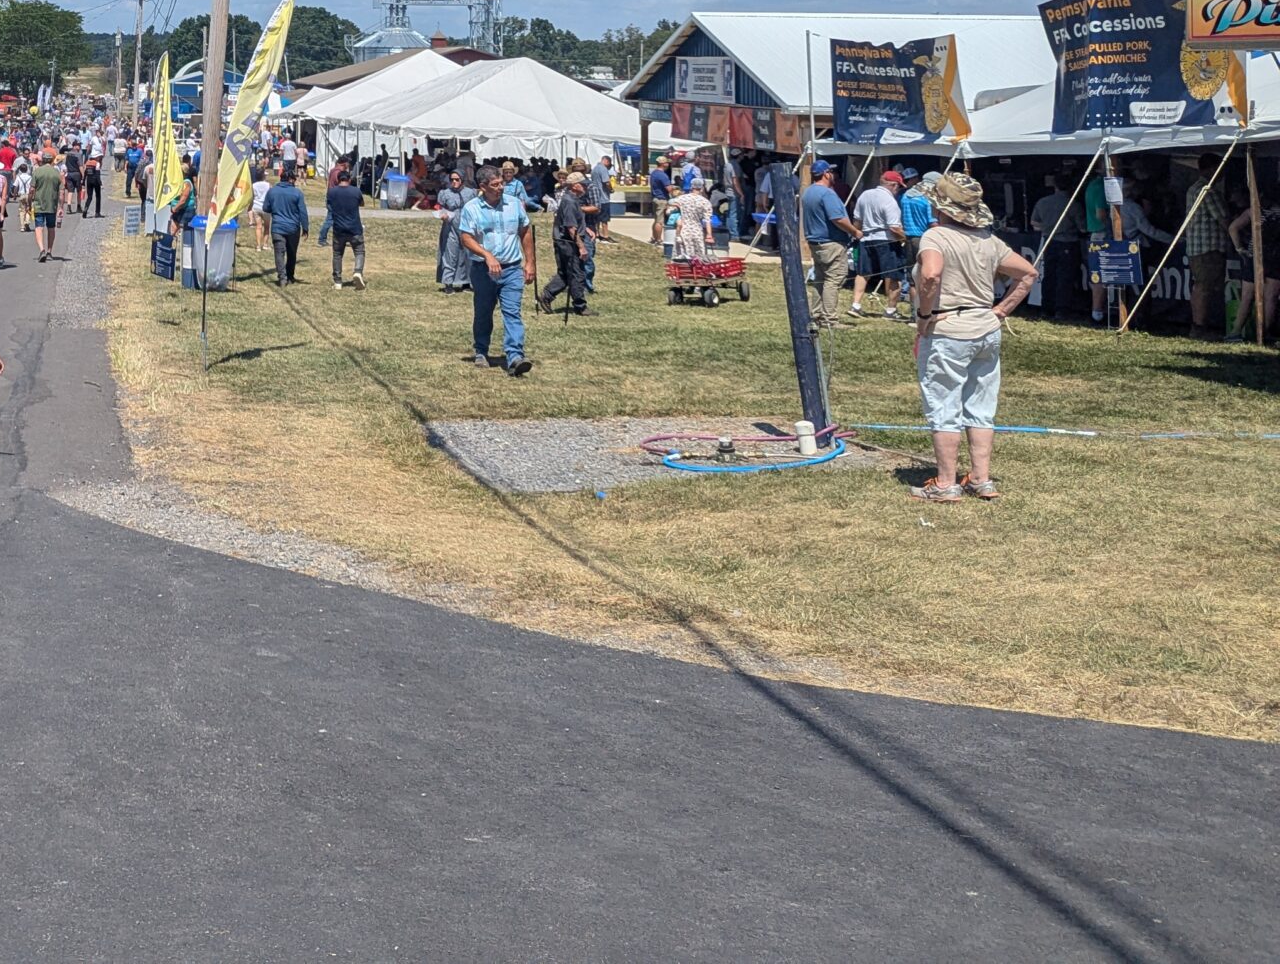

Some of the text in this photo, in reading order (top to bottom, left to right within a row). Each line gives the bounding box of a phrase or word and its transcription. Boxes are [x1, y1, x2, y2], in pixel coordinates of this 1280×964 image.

[1089, 42, 1123, 53] PULLED
[1126, 40, 1152, 52] PORK,
[1088, 53, 1147, 65] ANDWICHES
[835, 61, 857, 74] FFA
